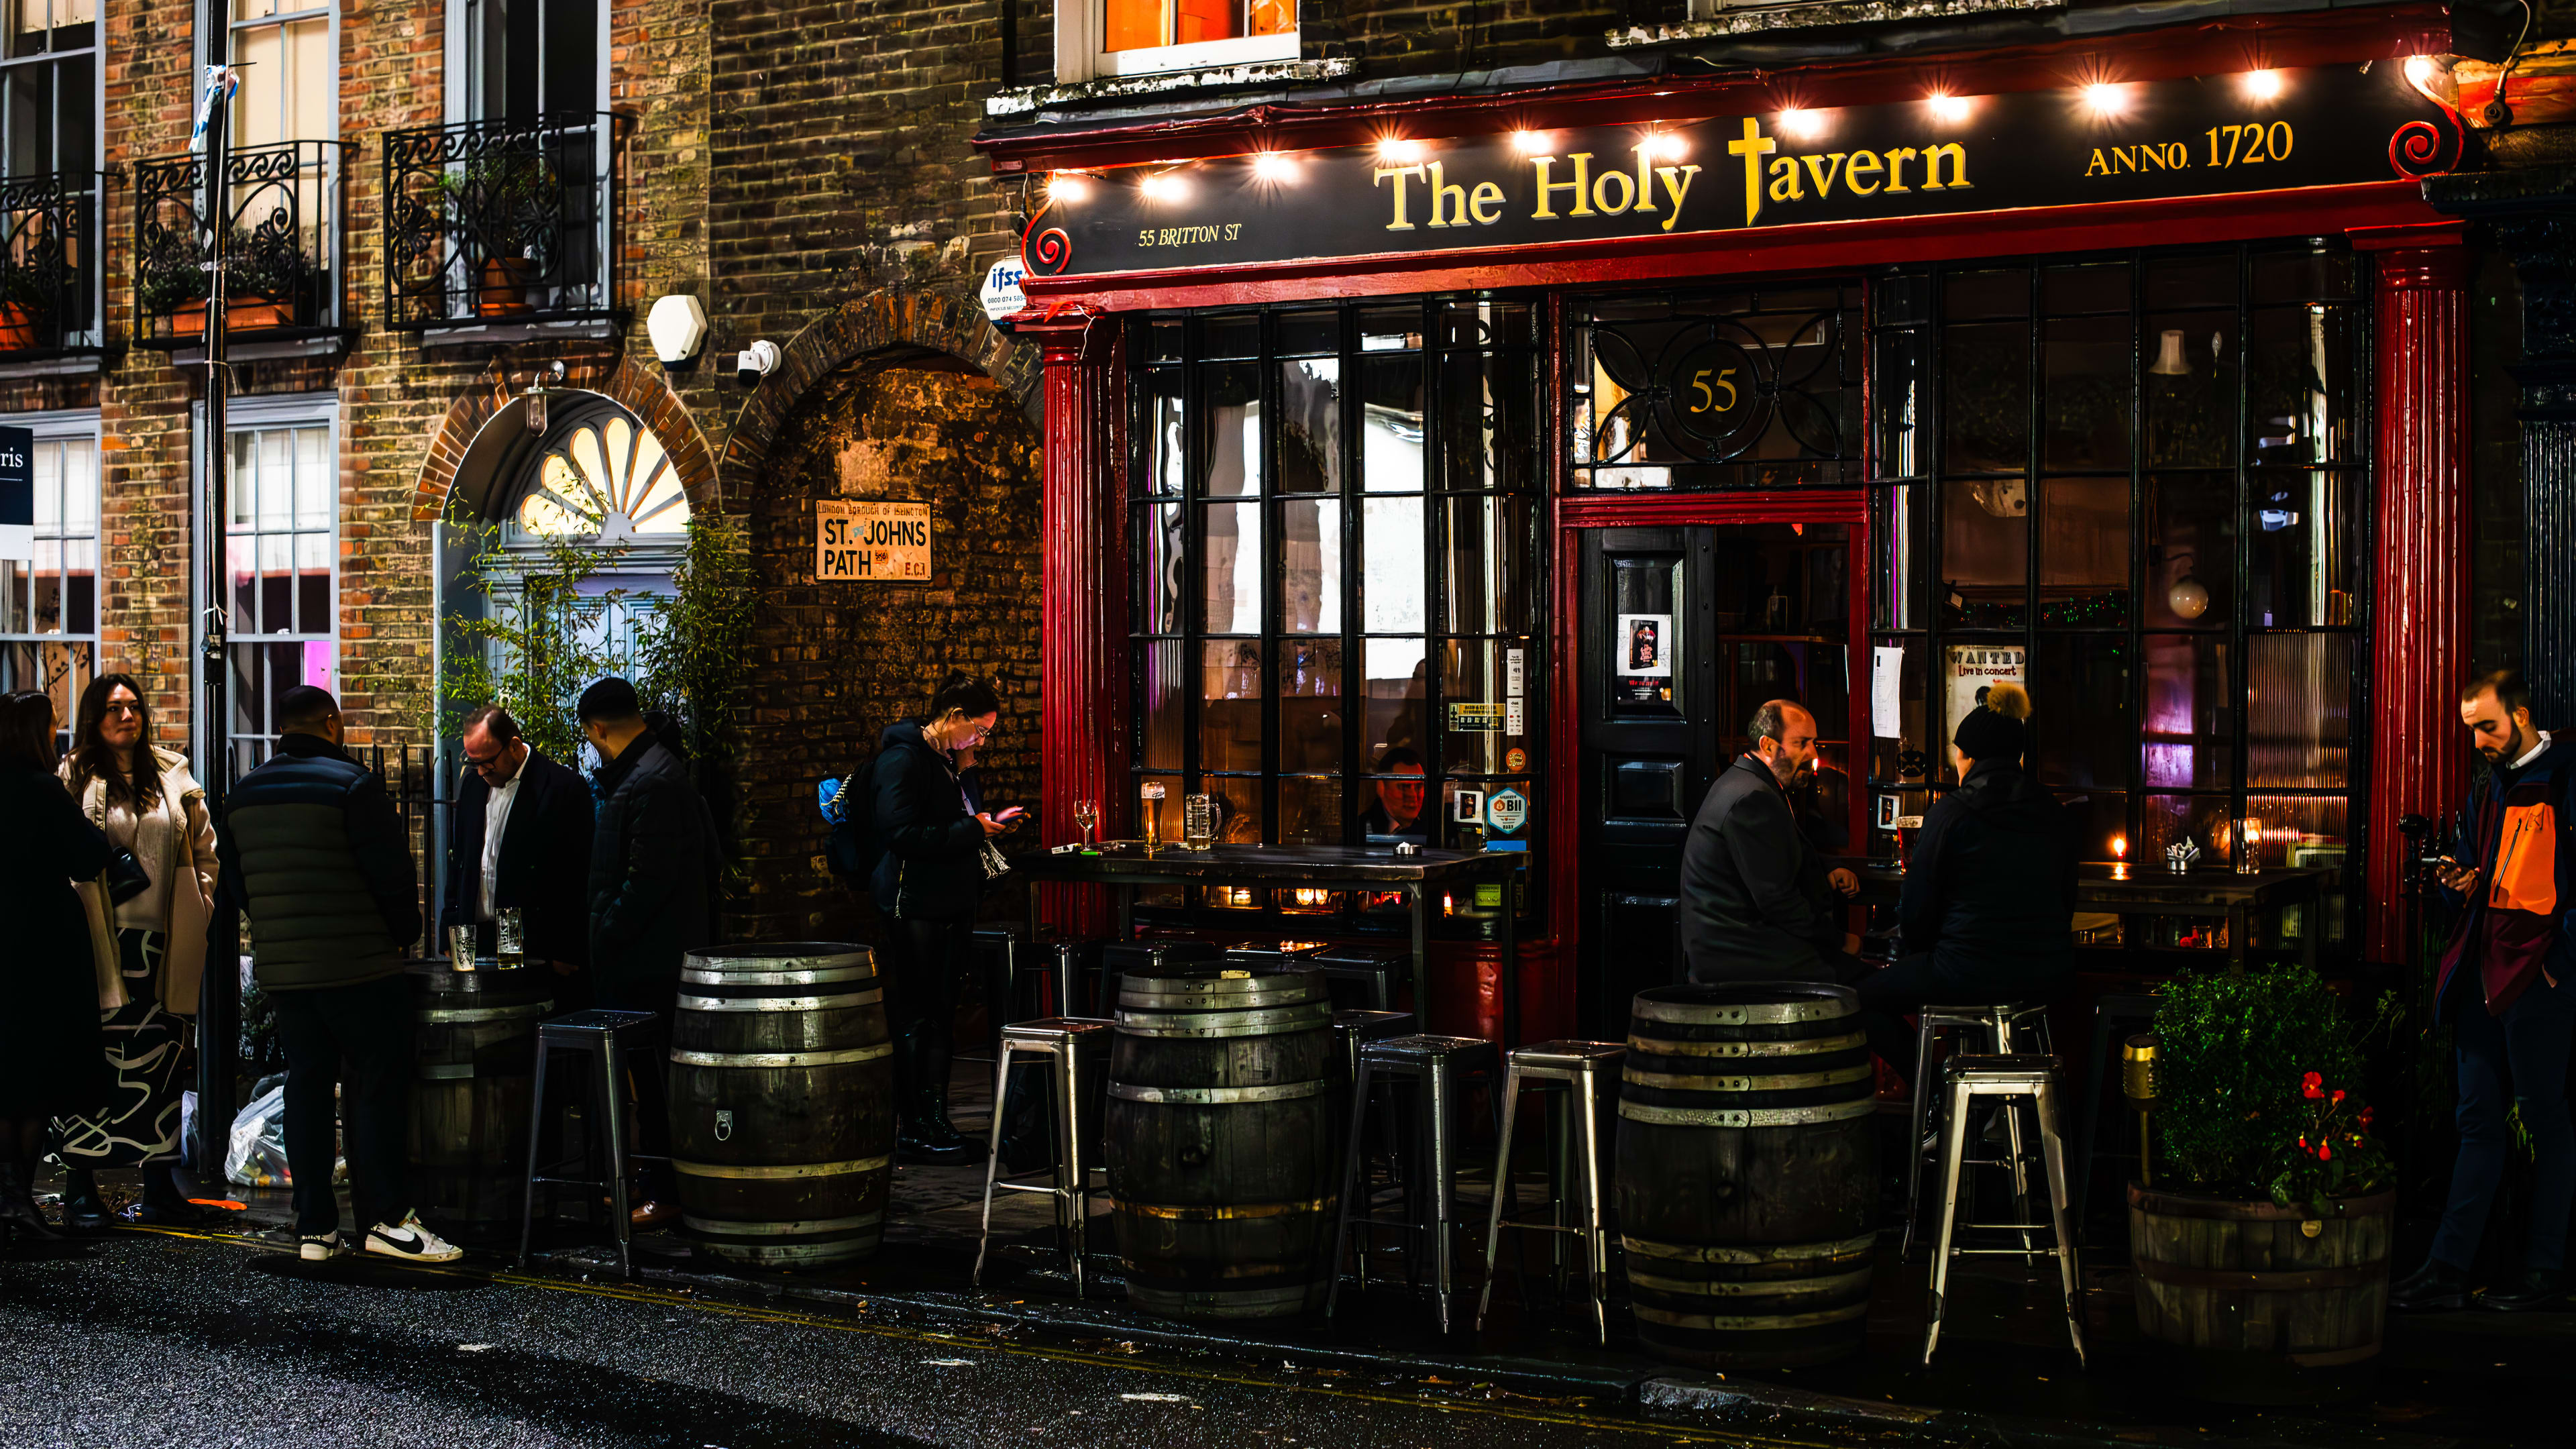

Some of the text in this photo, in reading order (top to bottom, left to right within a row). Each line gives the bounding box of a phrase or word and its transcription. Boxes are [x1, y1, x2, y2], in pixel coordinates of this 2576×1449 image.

[2084, 120, 2294, 177] ANNO. 1720
[1373, 160, 1506, 231] The
[1529, 142, 1703, 233] Holy
[1138, 223, 1242, 248] 55 BRITTON ST
[992, 266, 1023, 293] ifss
[1690, 368, 1737, 413] 55
[0, 447, 23, 468] ris
[818, 504, 845, 515] LONDON
[848, 505, 879, 516] BOROUGH
[882, 506, 890, 516] OF
[824, 519, 927, 547] ST. JOHNS
[824, 549, 871, 576] PATH
[1948, 651, 2025, 665] WANTED
[1958, 665, 2017, 677] Live in concert
